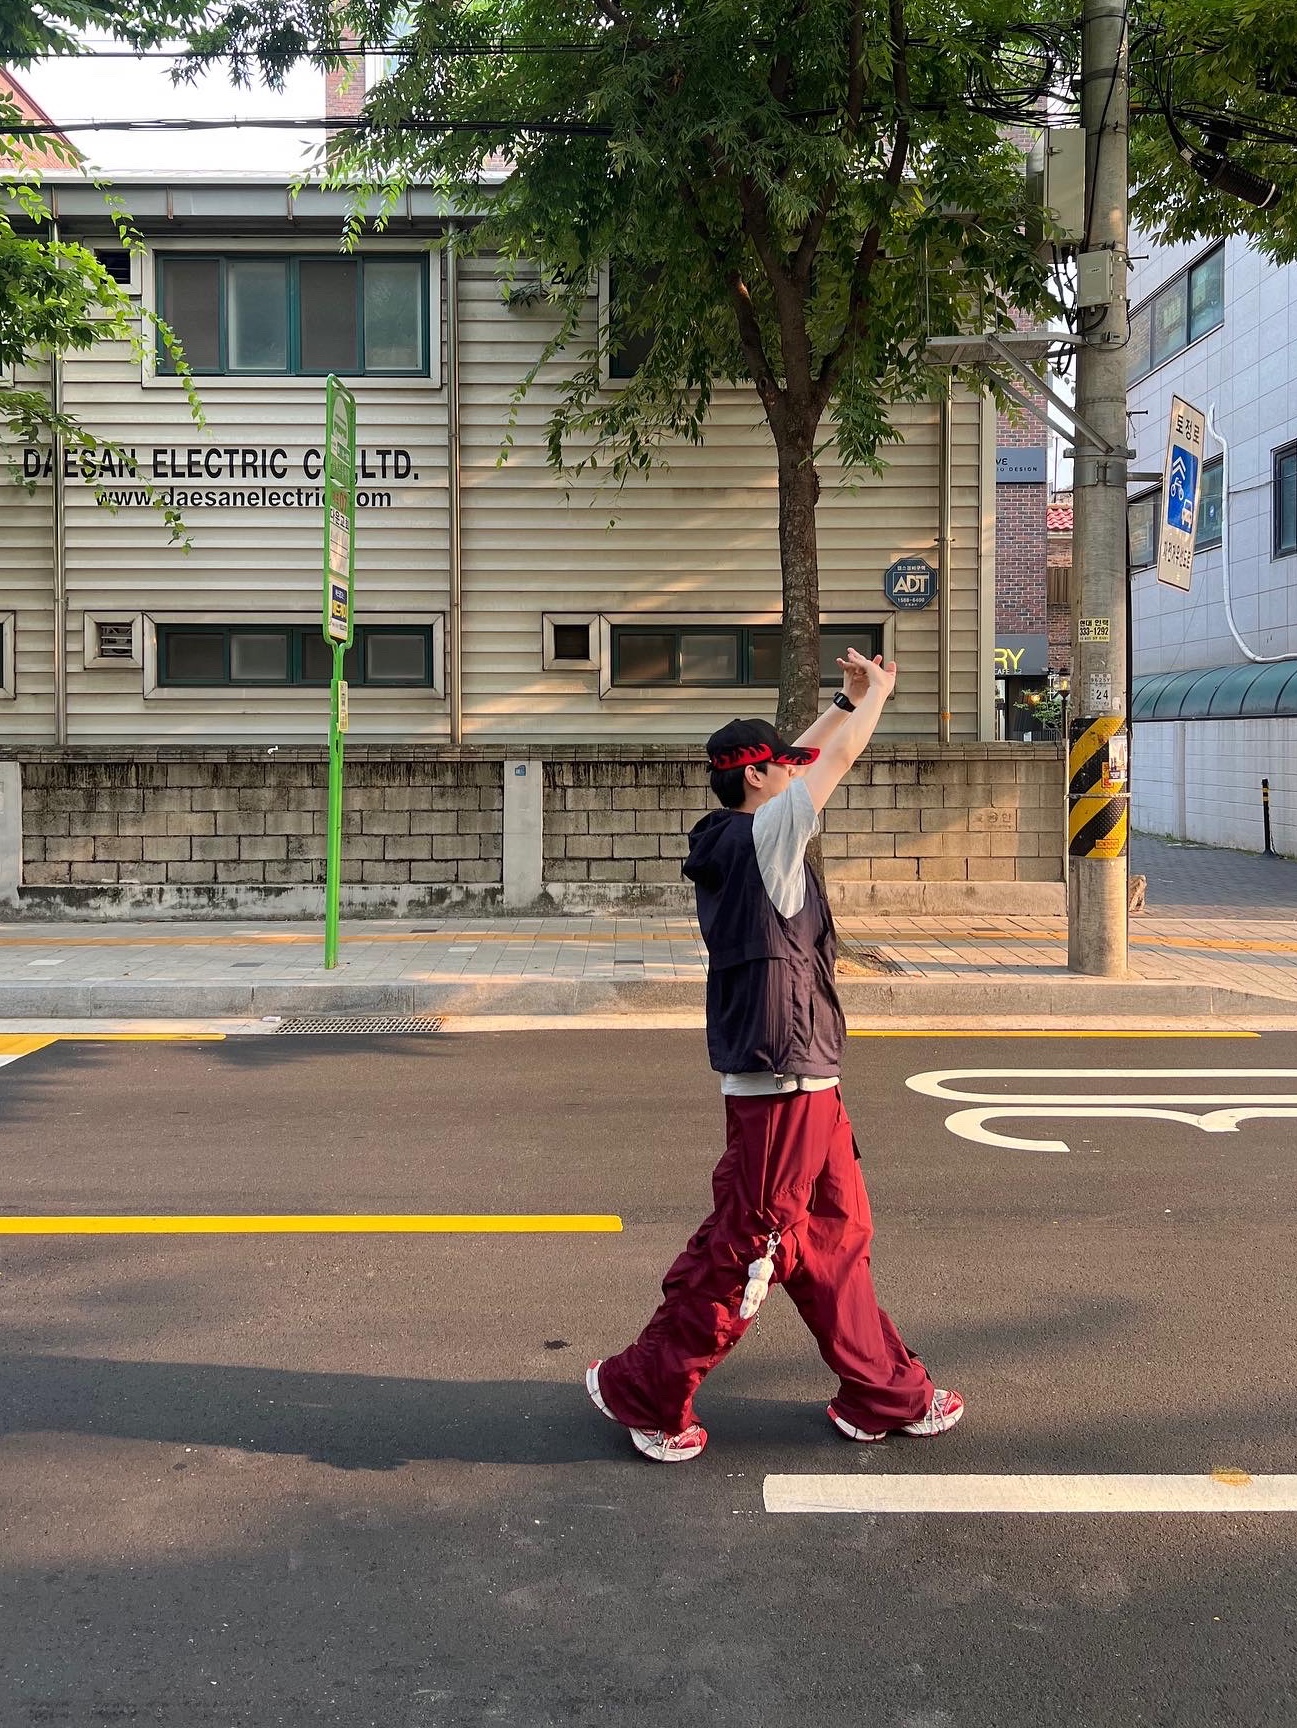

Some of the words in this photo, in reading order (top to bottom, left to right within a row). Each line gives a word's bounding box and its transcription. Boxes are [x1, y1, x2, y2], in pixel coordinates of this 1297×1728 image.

[1175, 414, 1200, 446] 토정로
[153, 447, 289, 480] ELECTRIC
[893, 575, 929, 593] ADT
[1080, 627, 1109, 636] 333-1292
[1096, 689, 1109, 700] 24
